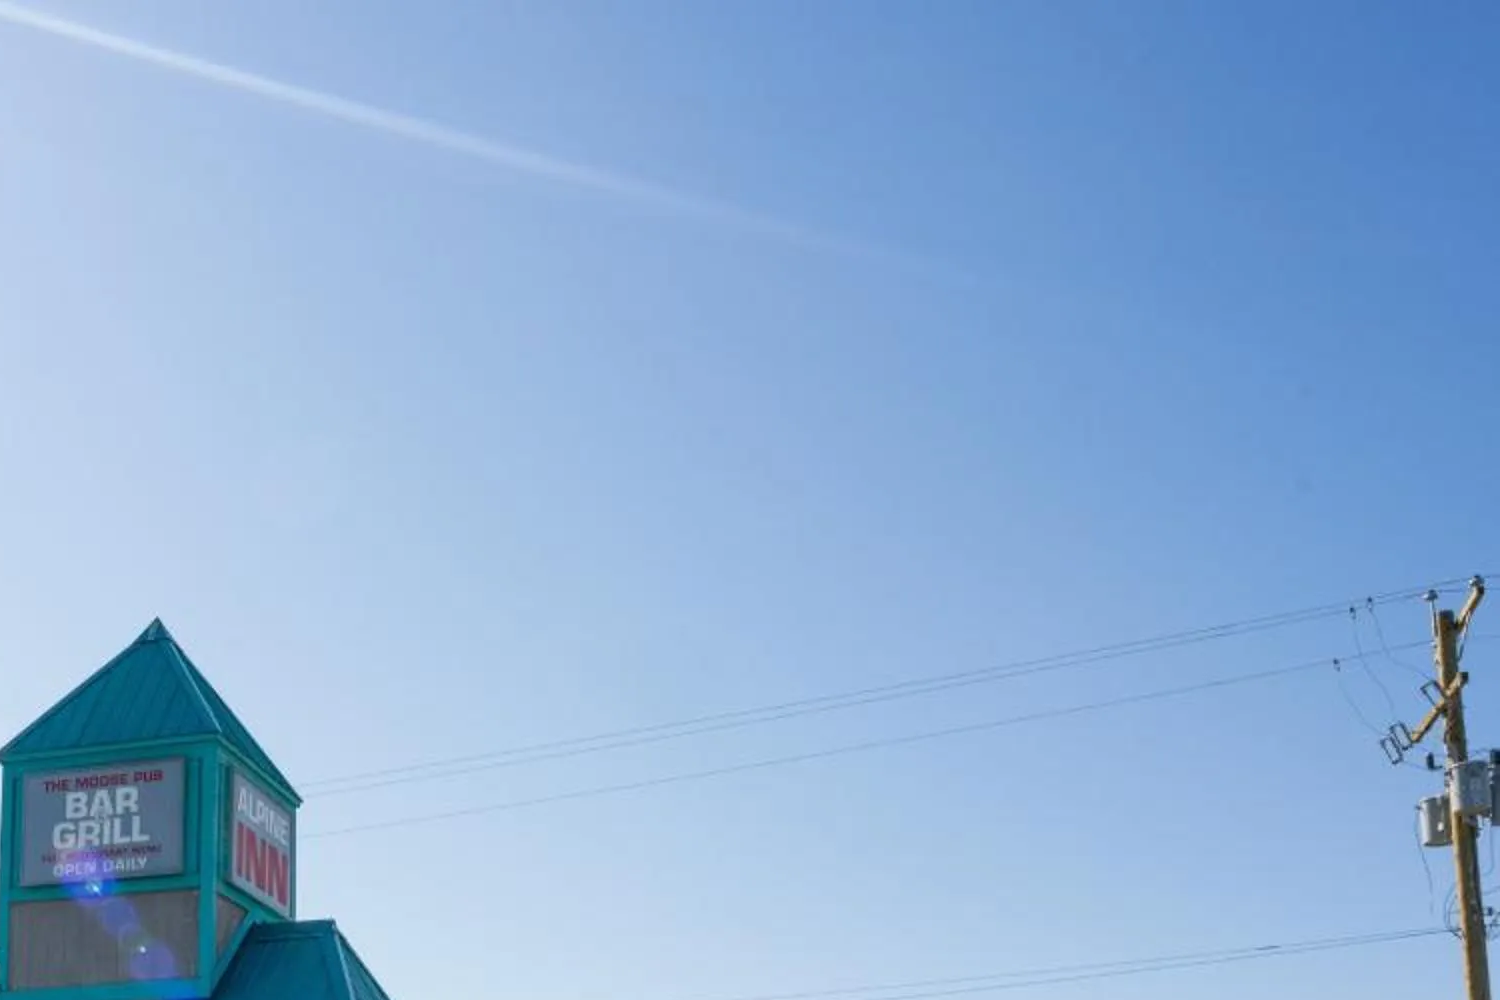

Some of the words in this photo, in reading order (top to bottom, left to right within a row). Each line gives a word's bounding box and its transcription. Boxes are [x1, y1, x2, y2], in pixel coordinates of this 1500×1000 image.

[43, 779, 70, 794] THE
[75, 773, 129, 790] MOOSE
[133, 769, 164, 783] PUB
[65, 787, 139, 819] BAR
[237, 787, 289, 846] ALPINE
[53, 815, 150, 850] GRILL
[52, 859, 97, 879] OPEN
[103, 856, 148, 873] DAILY
[236, 821, 288, 907] INN
